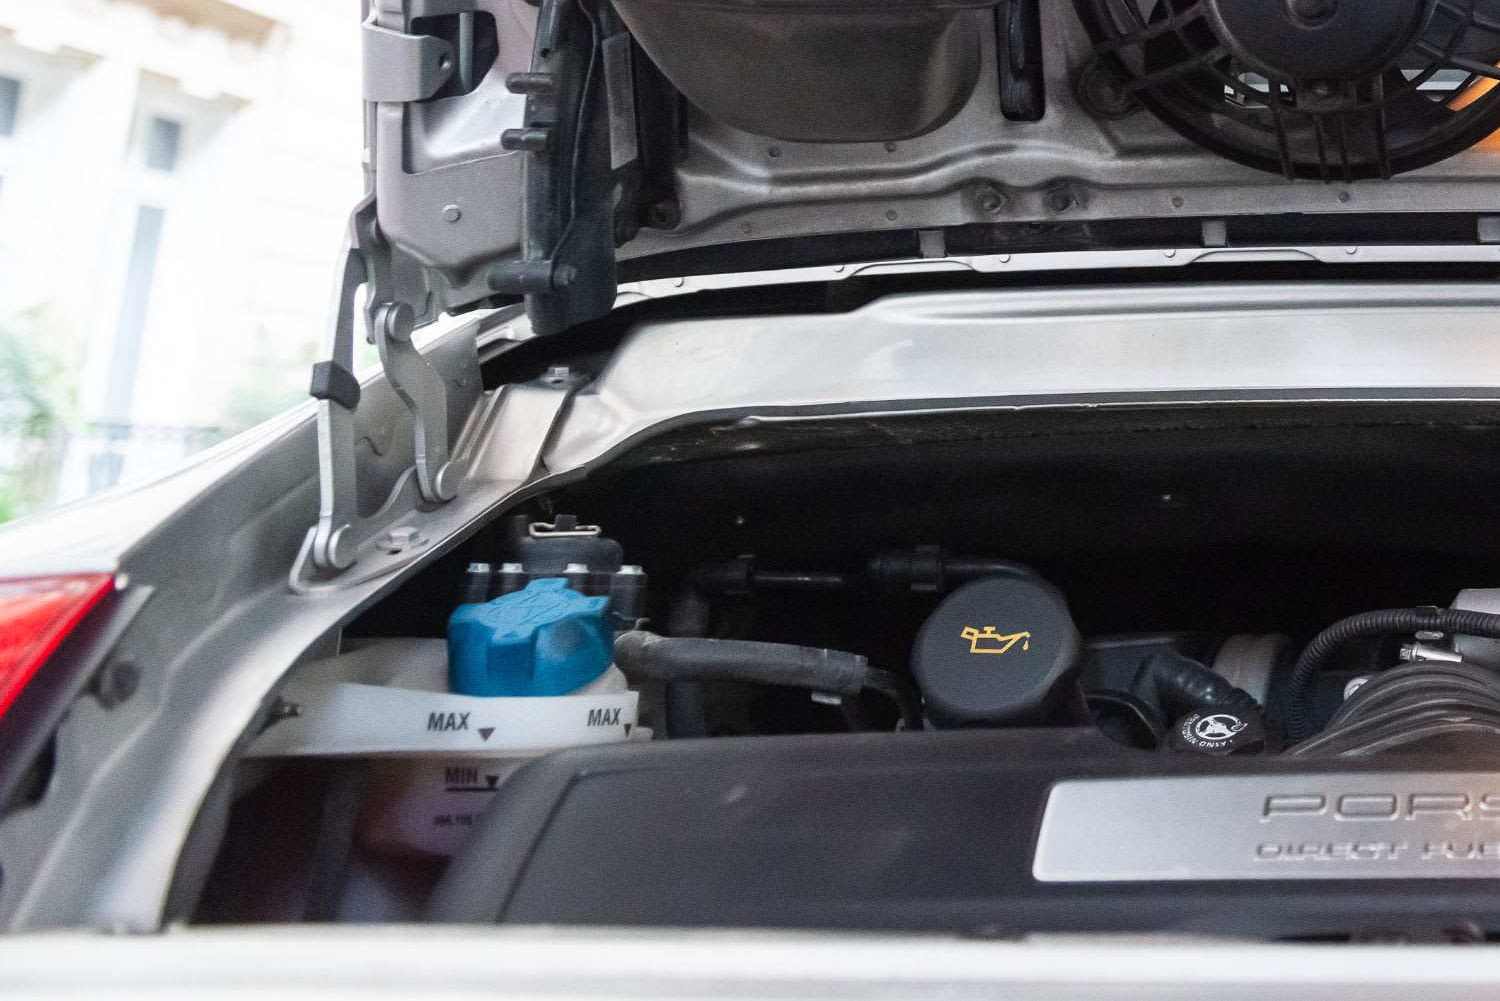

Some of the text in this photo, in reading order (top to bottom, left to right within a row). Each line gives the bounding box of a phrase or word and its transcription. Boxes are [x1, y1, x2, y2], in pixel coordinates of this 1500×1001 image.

[427, 712, 471, 731] MAX
[587, 708, 621, 727] MAX
[444, 766, 479, 784] MIN
[1254, 842, 1408, 861] DIRECT
